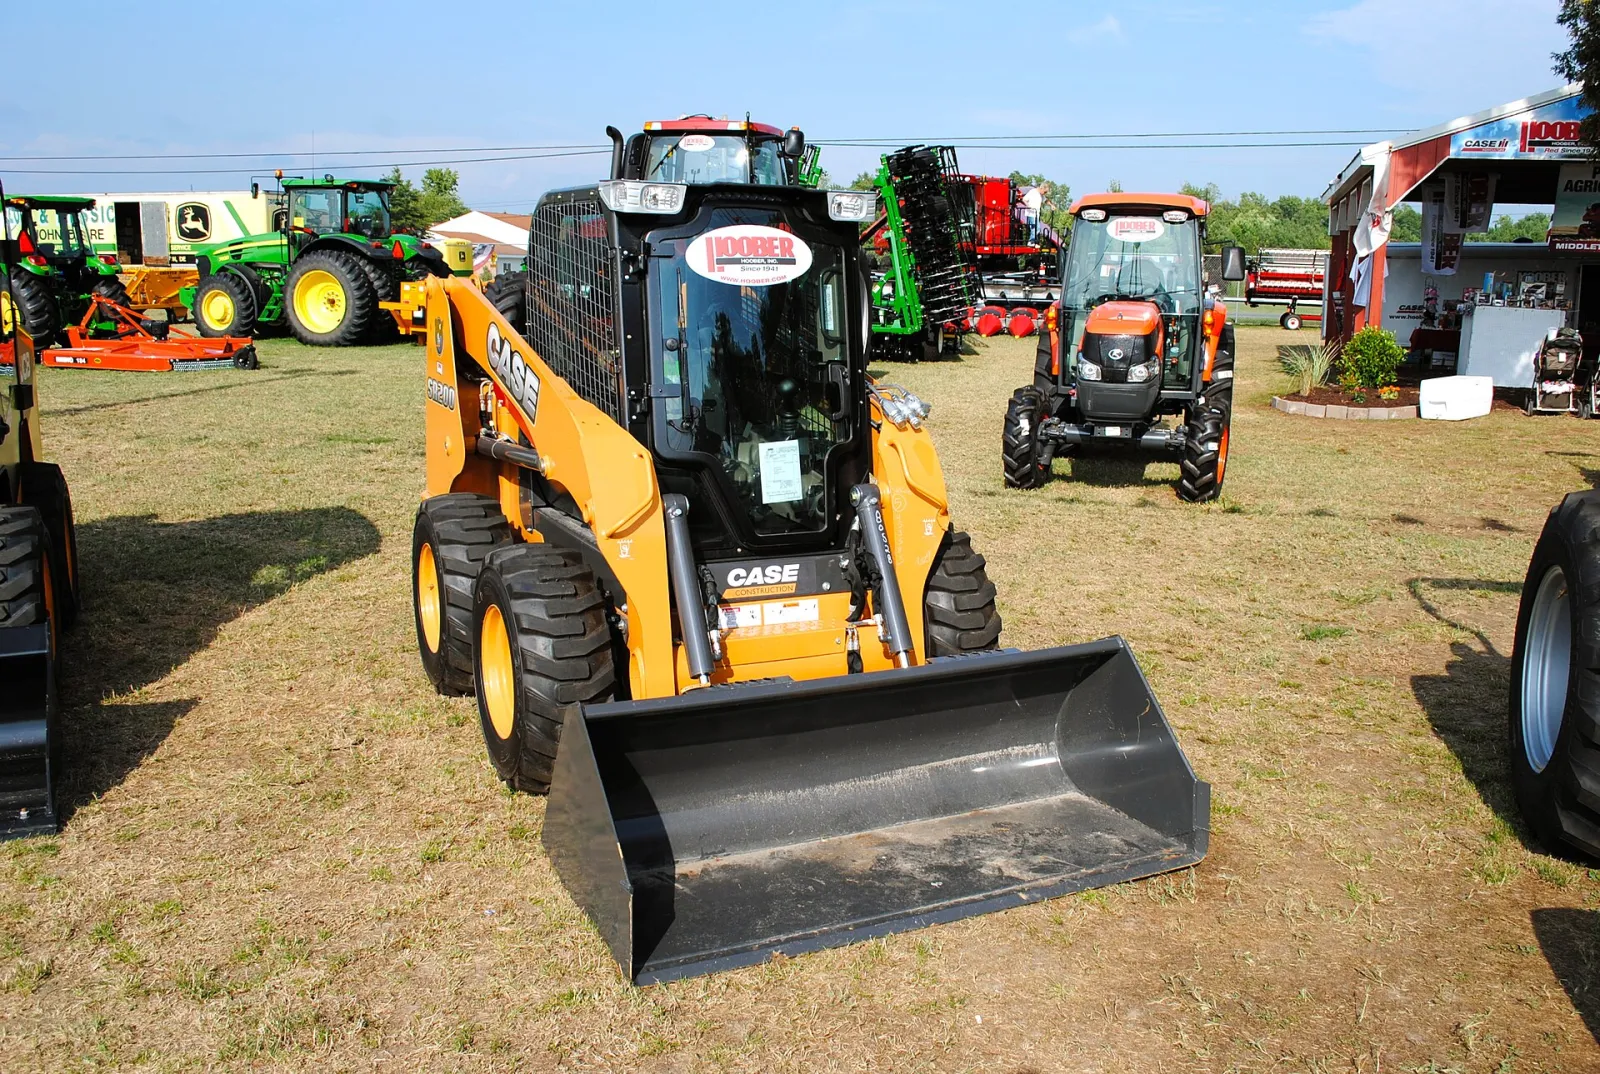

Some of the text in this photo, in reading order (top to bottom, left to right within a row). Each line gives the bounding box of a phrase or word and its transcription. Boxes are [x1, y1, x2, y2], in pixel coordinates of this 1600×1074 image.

[1464, 140, 1497, 148] CASE
[1563, 180, 1600, 192] AGRI
[705, 236, 794, 272] HOOBER
[720, 275, 787, 284] WWW.HOOBER.COM
[486, 321, 541, 426] CASE
[726, 564, 800, 587] CASE
[734, 584, 794, 597] CONSTRUCTION
